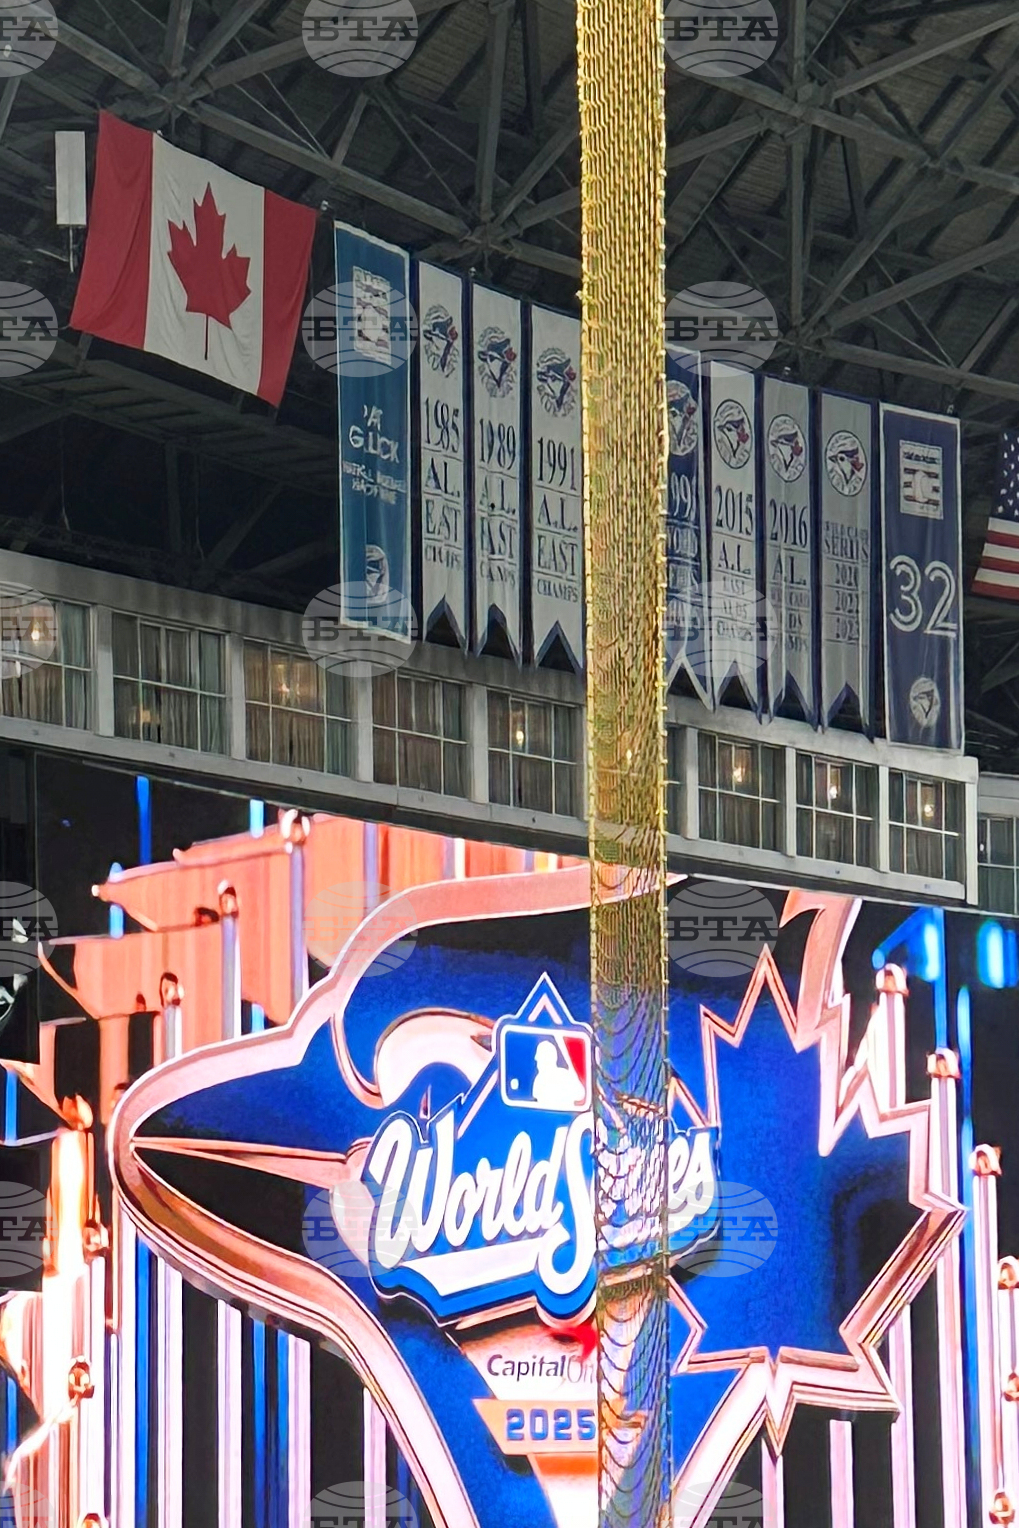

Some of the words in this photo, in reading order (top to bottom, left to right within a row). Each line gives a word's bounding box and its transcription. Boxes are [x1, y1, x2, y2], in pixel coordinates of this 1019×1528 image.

[537, 437, 577, 491] 1991
[714, 484, 754, 536] 2015
[768, 498, 808, 549] 2016
[537, 534, 578, 577] EAST
[889, 554, 958, 638] 32
[367, 1113, 567, 1254] World
[486, 1351, 595, 1383] CapitalOn
[506, 1408, 597, 1441] 2025
